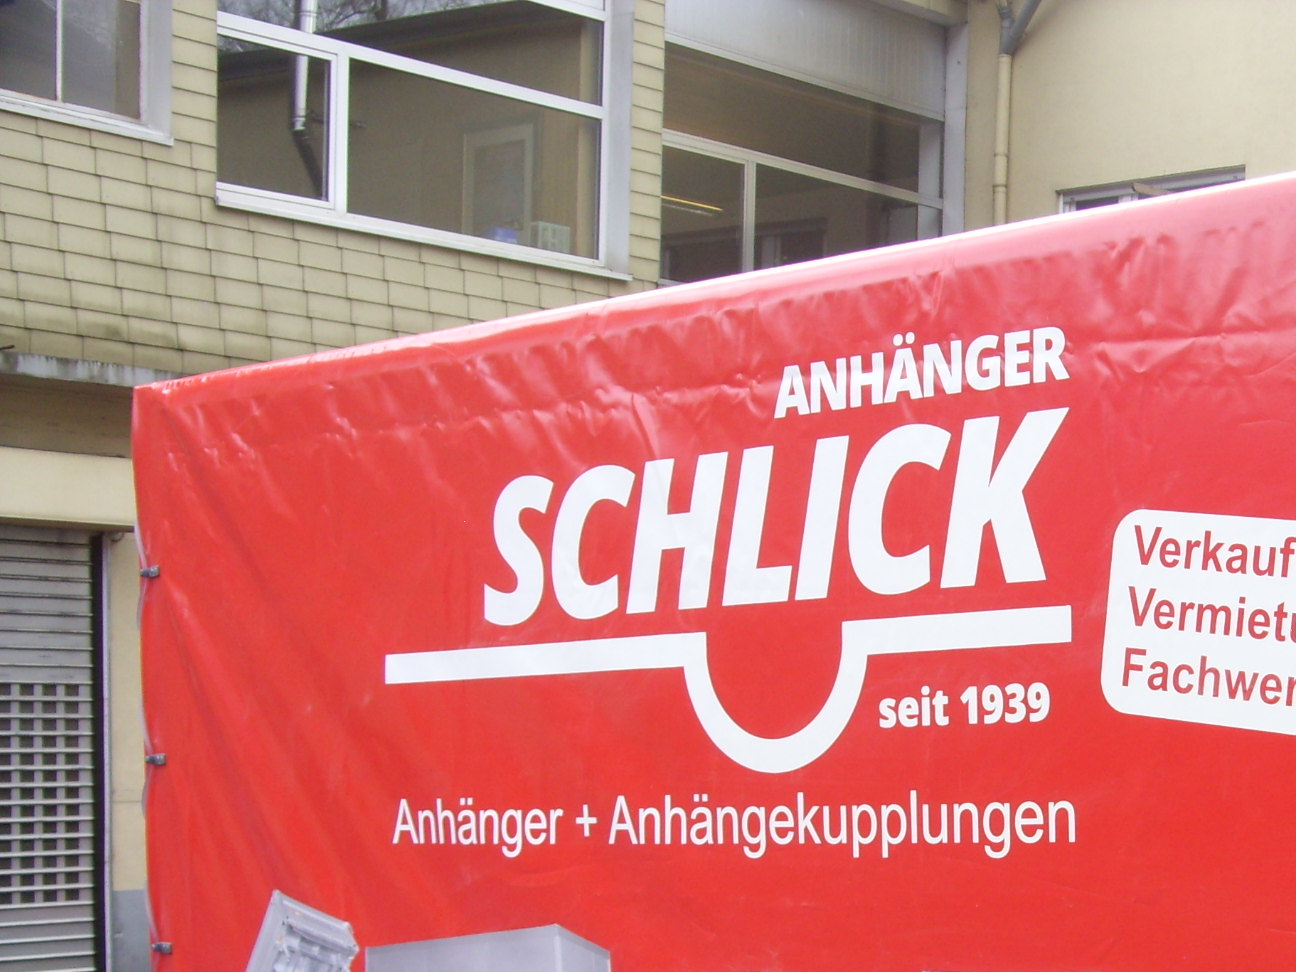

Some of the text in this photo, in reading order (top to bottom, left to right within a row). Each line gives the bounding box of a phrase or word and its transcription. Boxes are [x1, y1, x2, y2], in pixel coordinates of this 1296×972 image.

[774, 325, 1071, 419] ANHÄNGER
[484, 407, 1070, 627] SCHLICK
[879, 682, 1051, 729] seit 1939
[392, 796, 565, 858] Anhänger
[609, 790, 1077, 859] Anhängekupplungen
